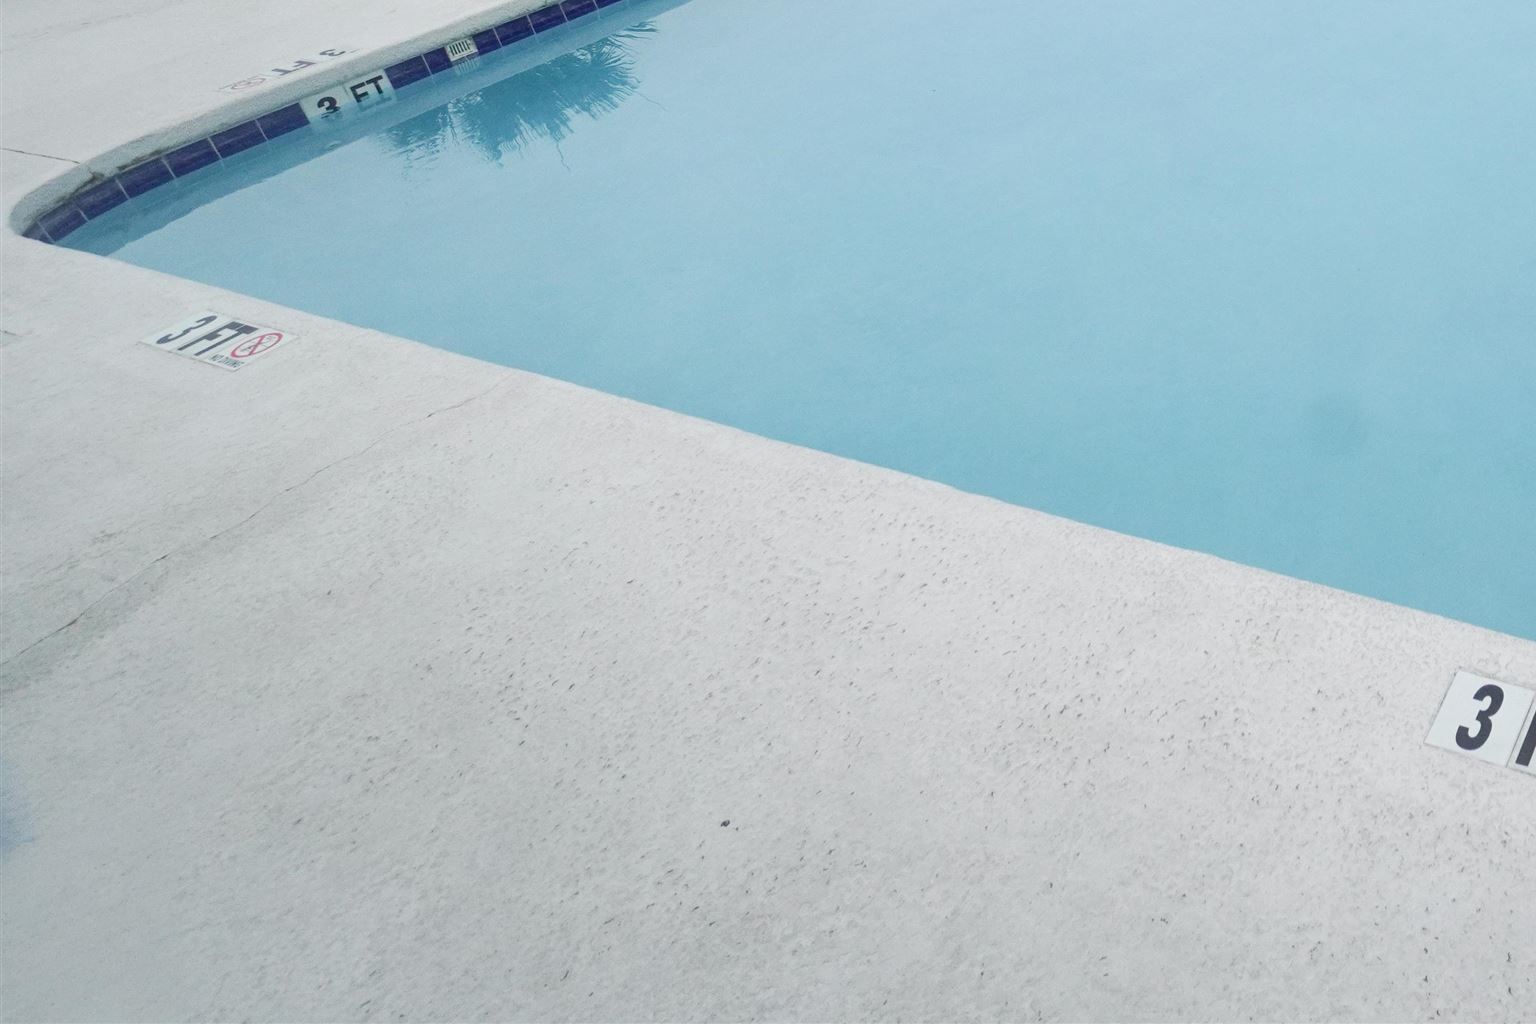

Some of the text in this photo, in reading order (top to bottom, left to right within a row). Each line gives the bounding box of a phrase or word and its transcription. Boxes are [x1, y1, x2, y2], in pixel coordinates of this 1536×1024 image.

[317, 75, 383, 117] 3 FT
[156, 315, 259, 356] 3 FT
[1455, 684, 1504, 751] 3
